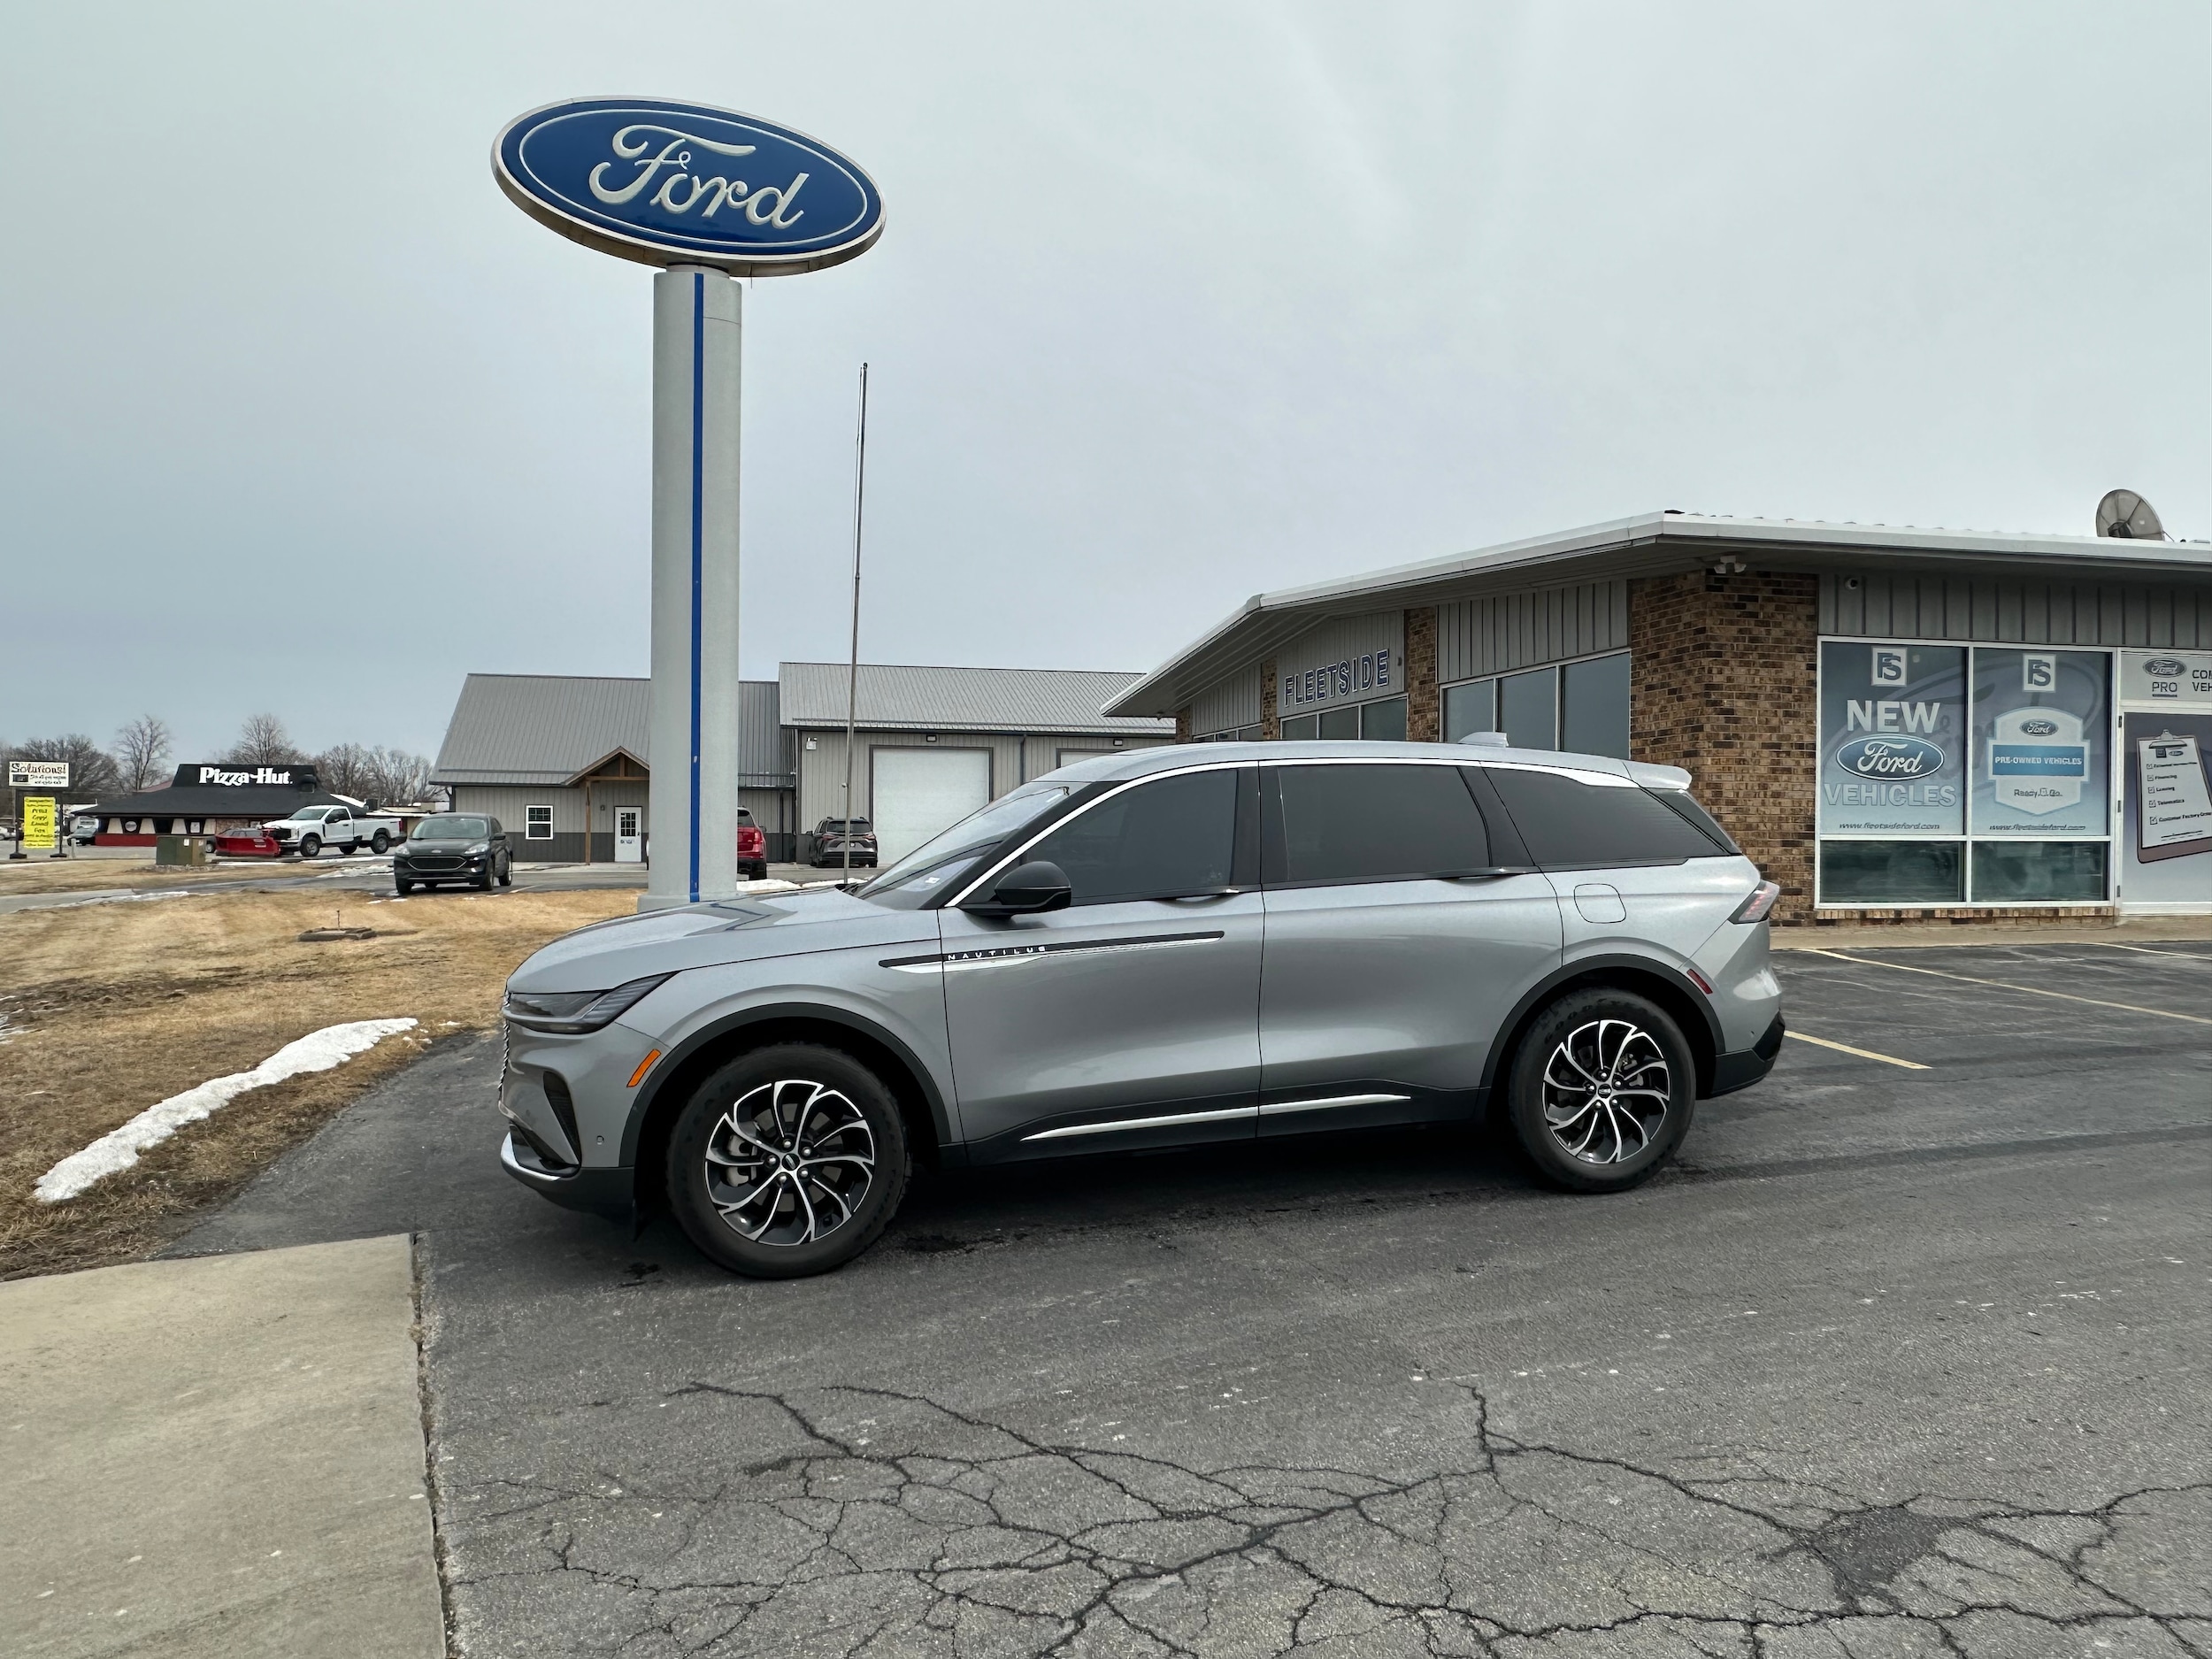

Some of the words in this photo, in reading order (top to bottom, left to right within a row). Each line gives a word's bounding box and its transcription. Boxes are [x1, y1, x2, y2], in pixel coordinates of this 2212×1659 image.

[588, 124, 810, 230] Ford
[1284, 649, 1390, 707] FLEETSIDE
[1877, 652, 1902, 680] FS
[2027, 659, 2052, 687] FS
[2150, 660, 2178, 674] Ford
[2152, 681, 2177, 693] PRO
[1847, 699, 1940, 733] NEW
[2027, 721, 2051, 733] Ford
[1856, 741, 1924, 773] Ford
[1994, 756, 2042, 764] PRE-OWNED
[2044, 757, 2083, 765] VEHICLES
[198, 766, 250, 787] Pizza
[1824, 783, 1957, 808] VEHICLES
[947, 946, 1046, 961] NAUTILUS
